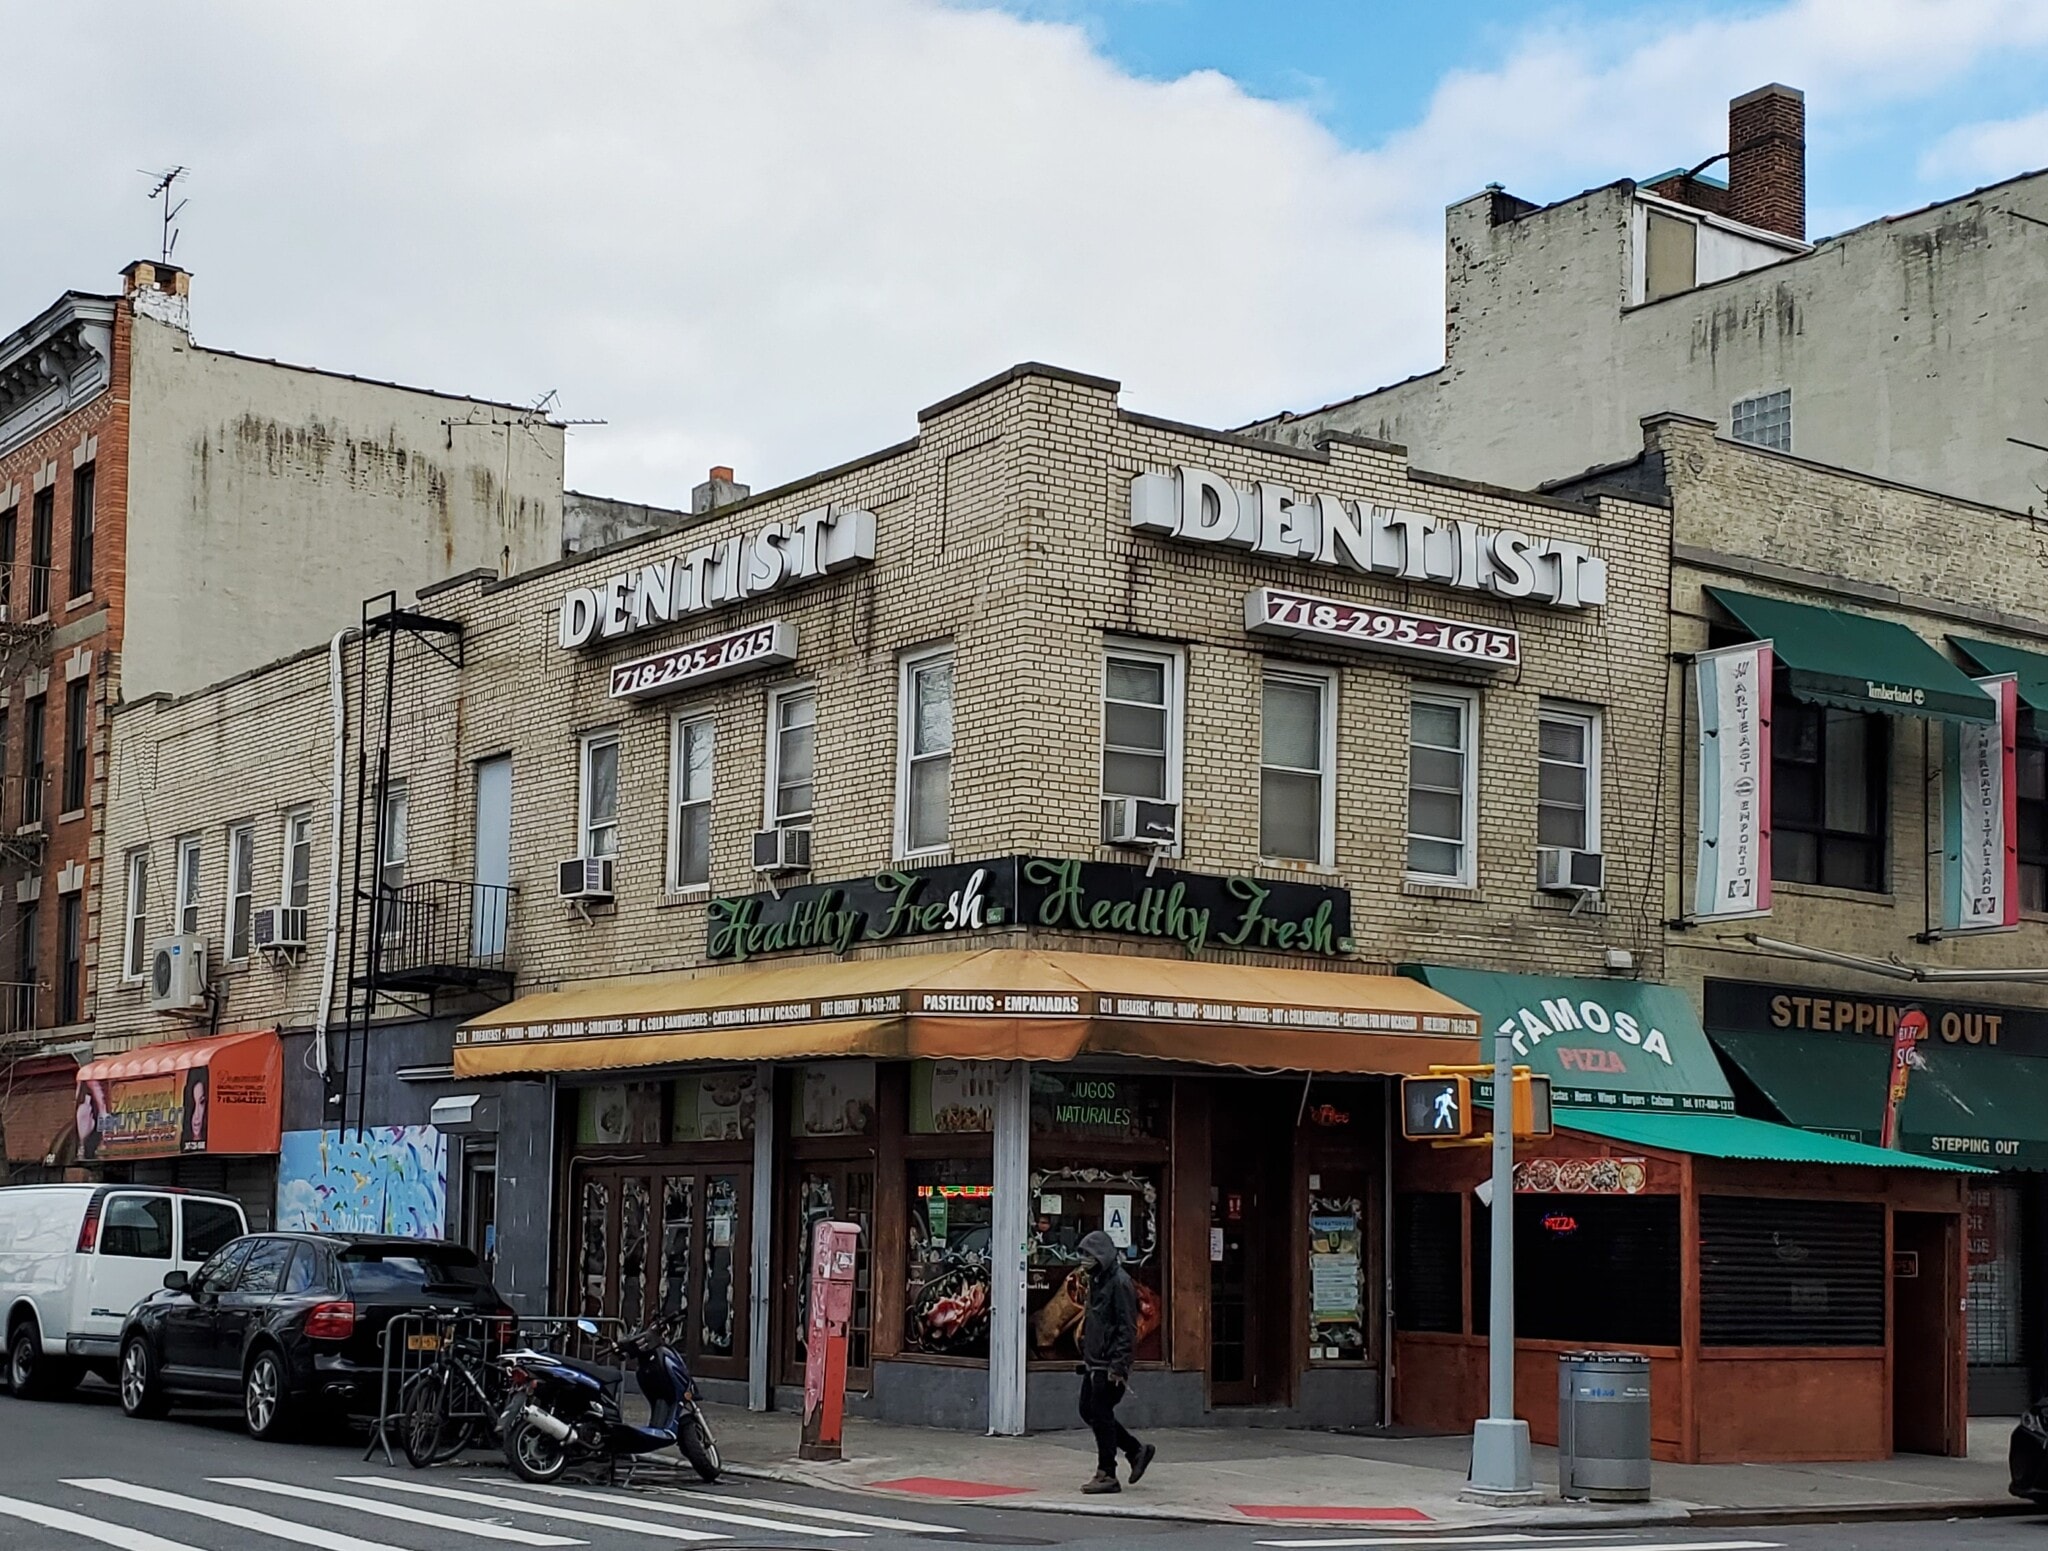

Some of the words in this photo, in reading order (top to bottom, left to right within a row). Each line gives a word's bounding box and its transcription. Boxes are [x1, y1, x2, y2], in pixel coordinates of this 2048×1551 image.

[1171, 465, 1589, 607] DENTIST
[560, 503, 838, 649] DENTIST
[1267, 596, 1511, 659] 718-295-1615
[615, 630, 772, 690] 718-295-1615
[1866, 681, 1913, 704] Timberland
[1738, 801, 1750, 877] EMPORIO
[1982, 818, 1993, 895] ITALIANO
[707, 887, 857, 960] Healthy
[867, 868, 986, 940] Fresh
[1024, 858, 1209, 953] Healthy
[1219, 875, 1334, 955] Fresh
[712, 1008, 745, 1026] CATERING
[746, 1008, 760, 1022] FOR
[760, 1006, 775, 1021] ANY
[820, 1002, 834, 1017] FREE
[923, 994, 994, 1011] PASTELITOS
[1004, 996, 1079, 1013] EMPANADAS
[1771, 995, 1928, 1040] STEPPIN
[1940, 1012, 2002, 1045] OUT
[1499, 998, 1674, 1065] FAMOSA
[1557, 1047, 1627, 1073] PIZZA
[1056, 1105, 1131, 1125] NATURALES
[1072, 1082, 1116, 1099] JUGOS
[1931, 1137, 1990, 1153] STEPPING
[1995, 1140, 2019, 1155] OUT
[1110, 1209, 1123, 1228] A
